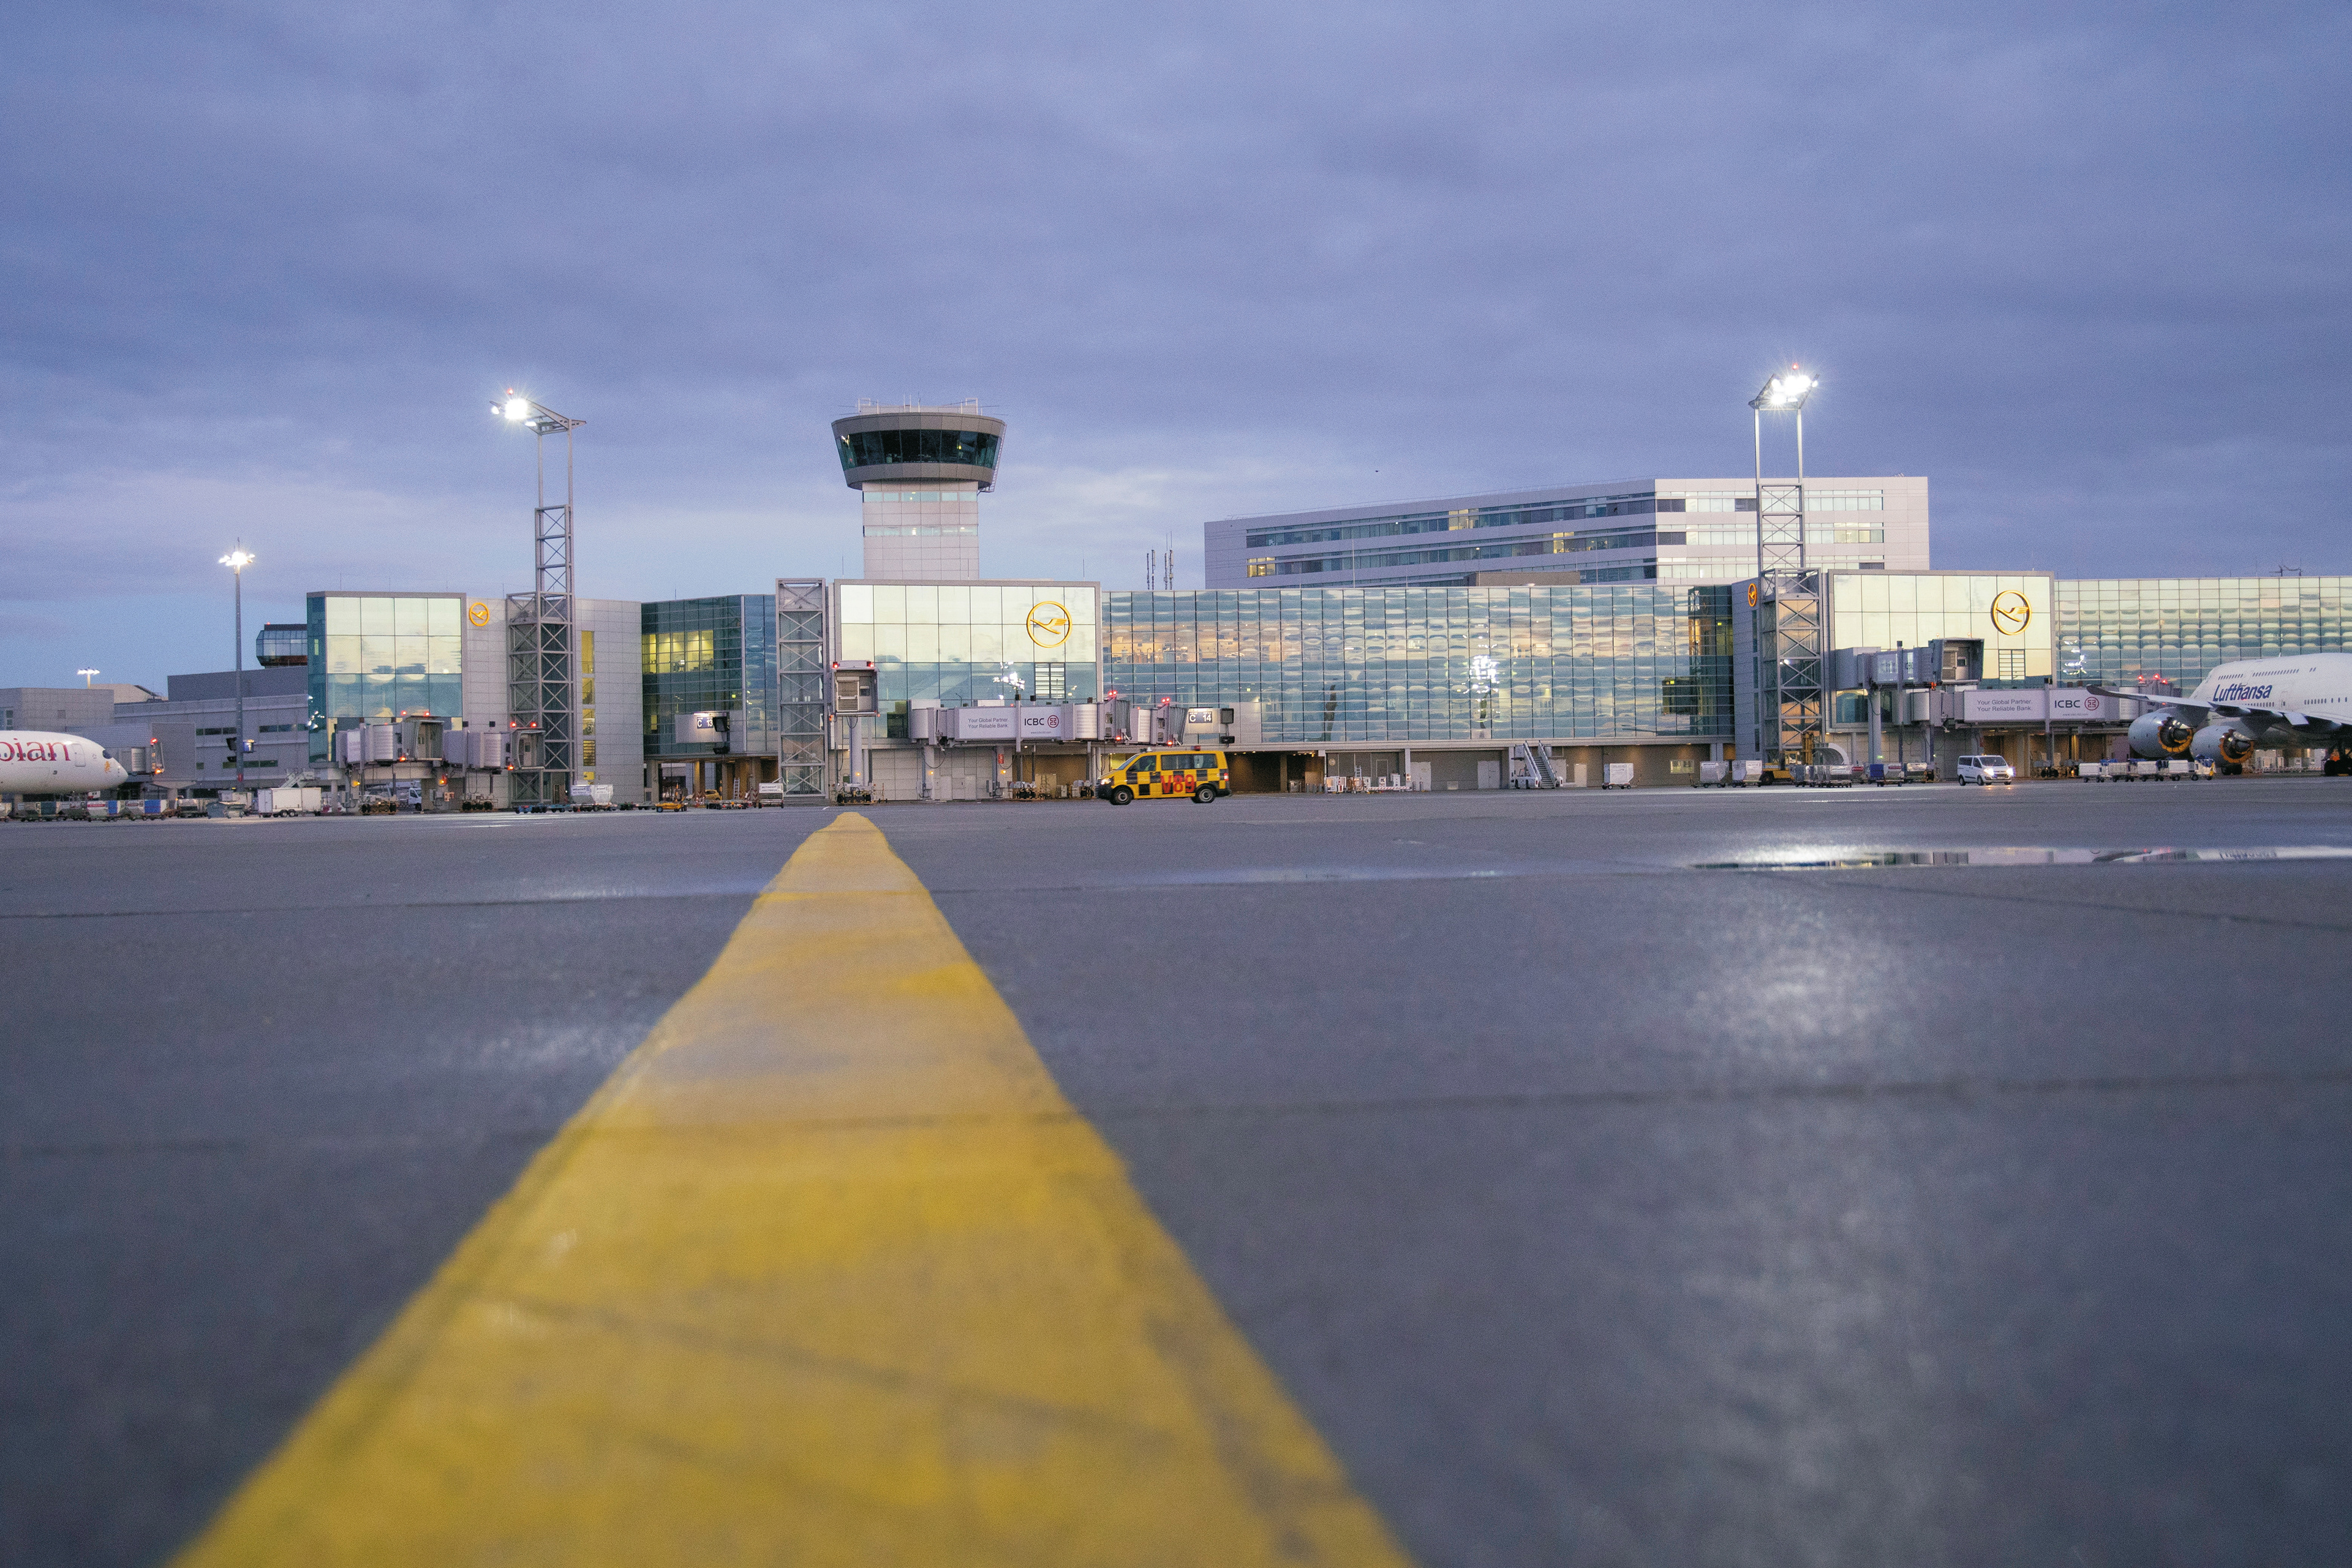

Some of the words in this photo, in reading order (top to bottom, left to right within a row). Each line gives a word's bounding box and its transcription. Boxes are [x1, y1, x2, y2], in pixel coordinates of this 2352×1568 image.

[2212, 683, 2273, 702] Lufthansa
[2054, 699, 2081, 708] ICBC
[1160, 774, 1196, 793] V89
